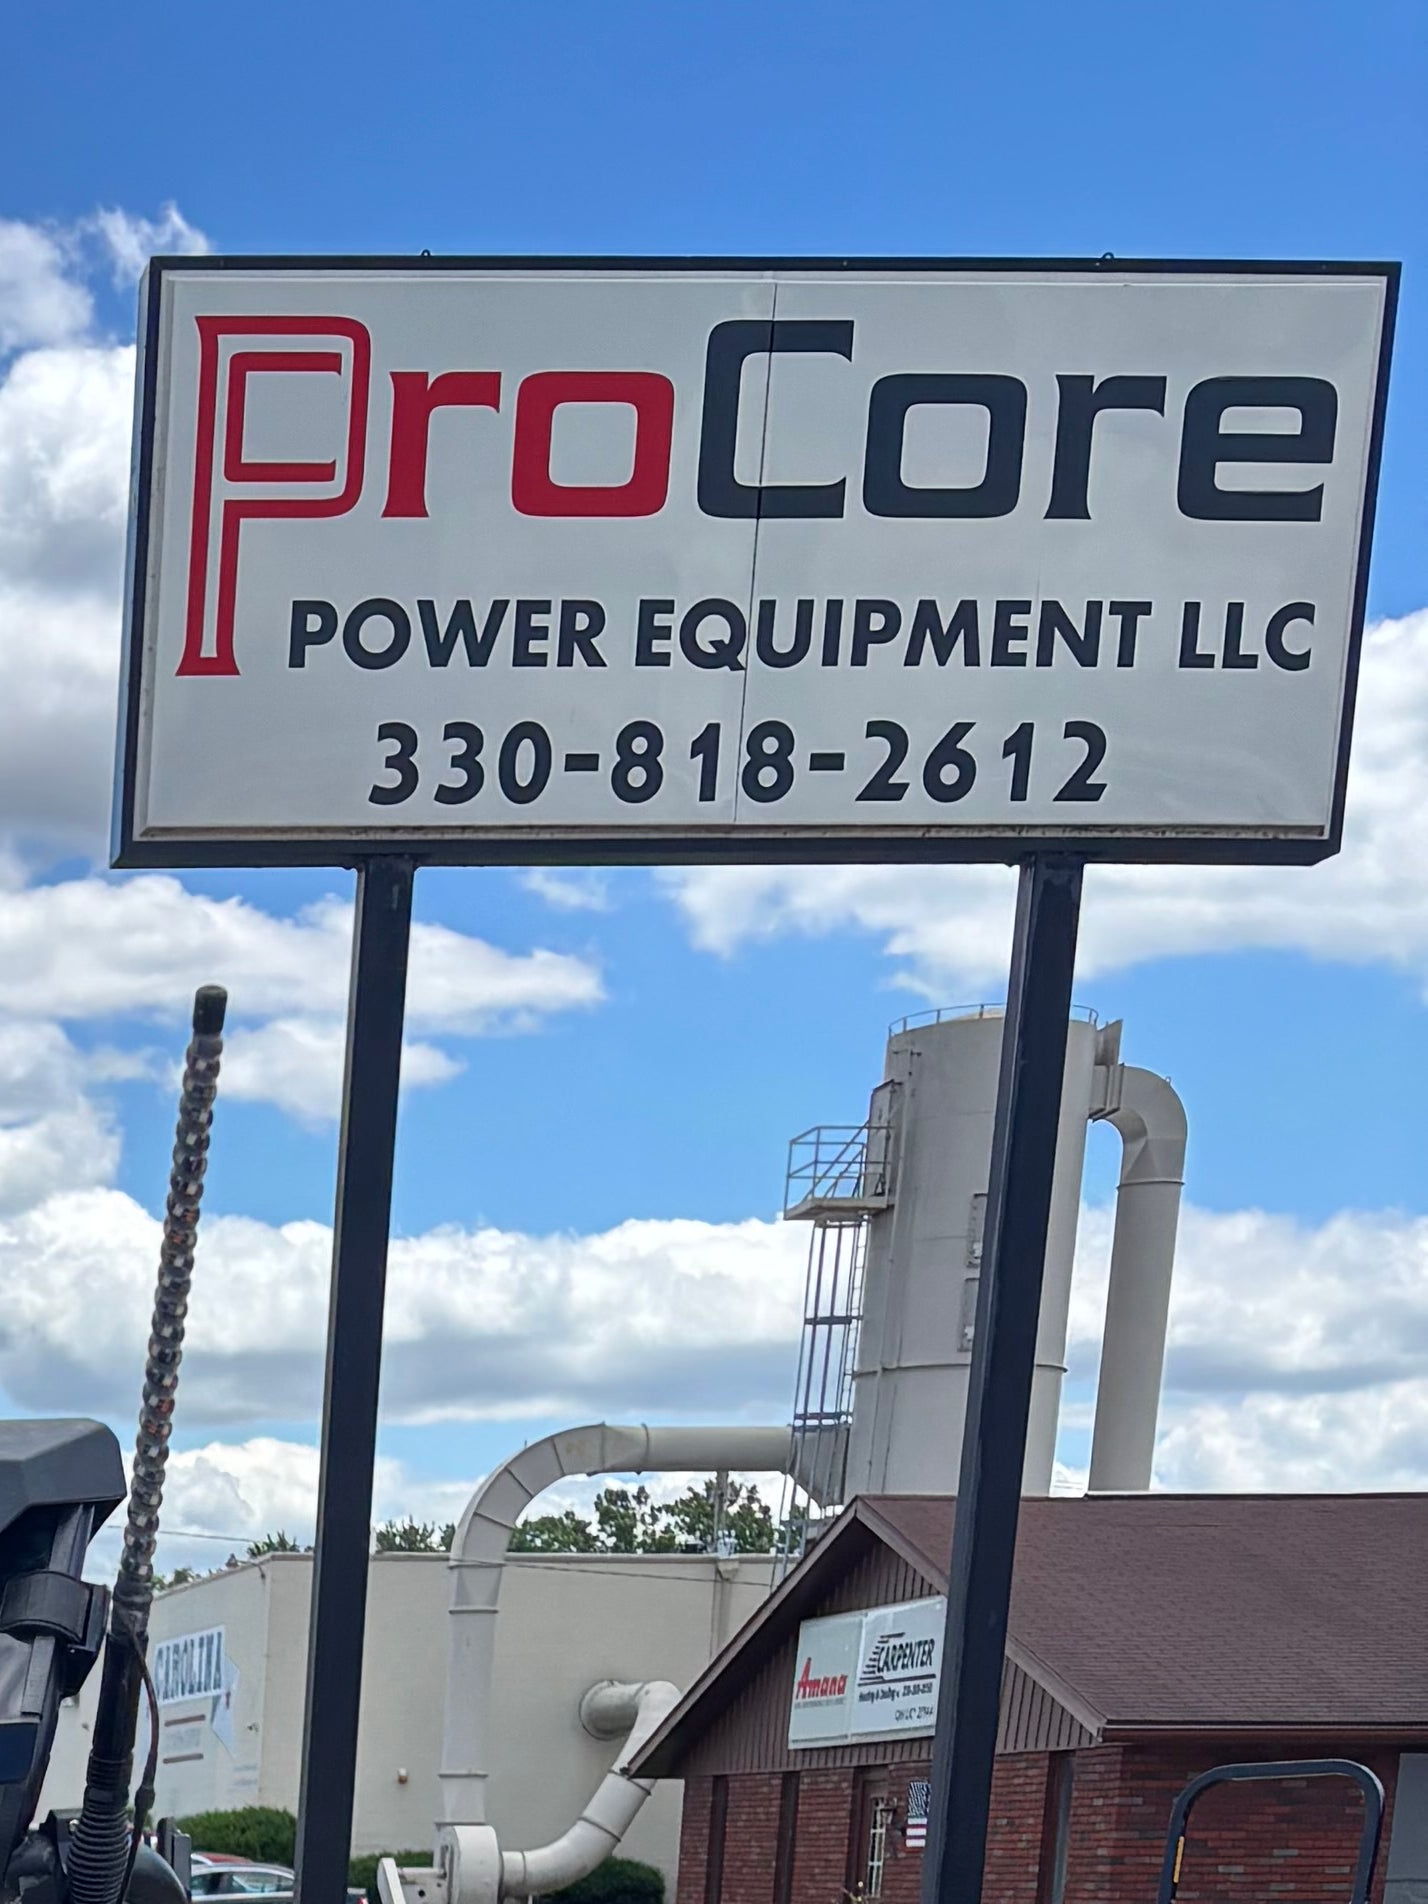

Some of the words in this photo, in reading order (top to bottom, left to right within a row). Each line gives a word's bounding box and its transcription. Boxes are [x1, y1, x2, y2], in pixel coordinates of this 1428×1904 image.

[175, 316, 1339, 676] ProCore
[288, 597, 608, 670] POWER
[634, 597, 1153, 673] EQUIPMENT
[1178, 600, 1316, 672] LLC
[367, 719, 1110, 807] 330-818-2612
[795, 1656, 848, 1699] Amana
[876, 1638, 936, 1674] CARPENTER
